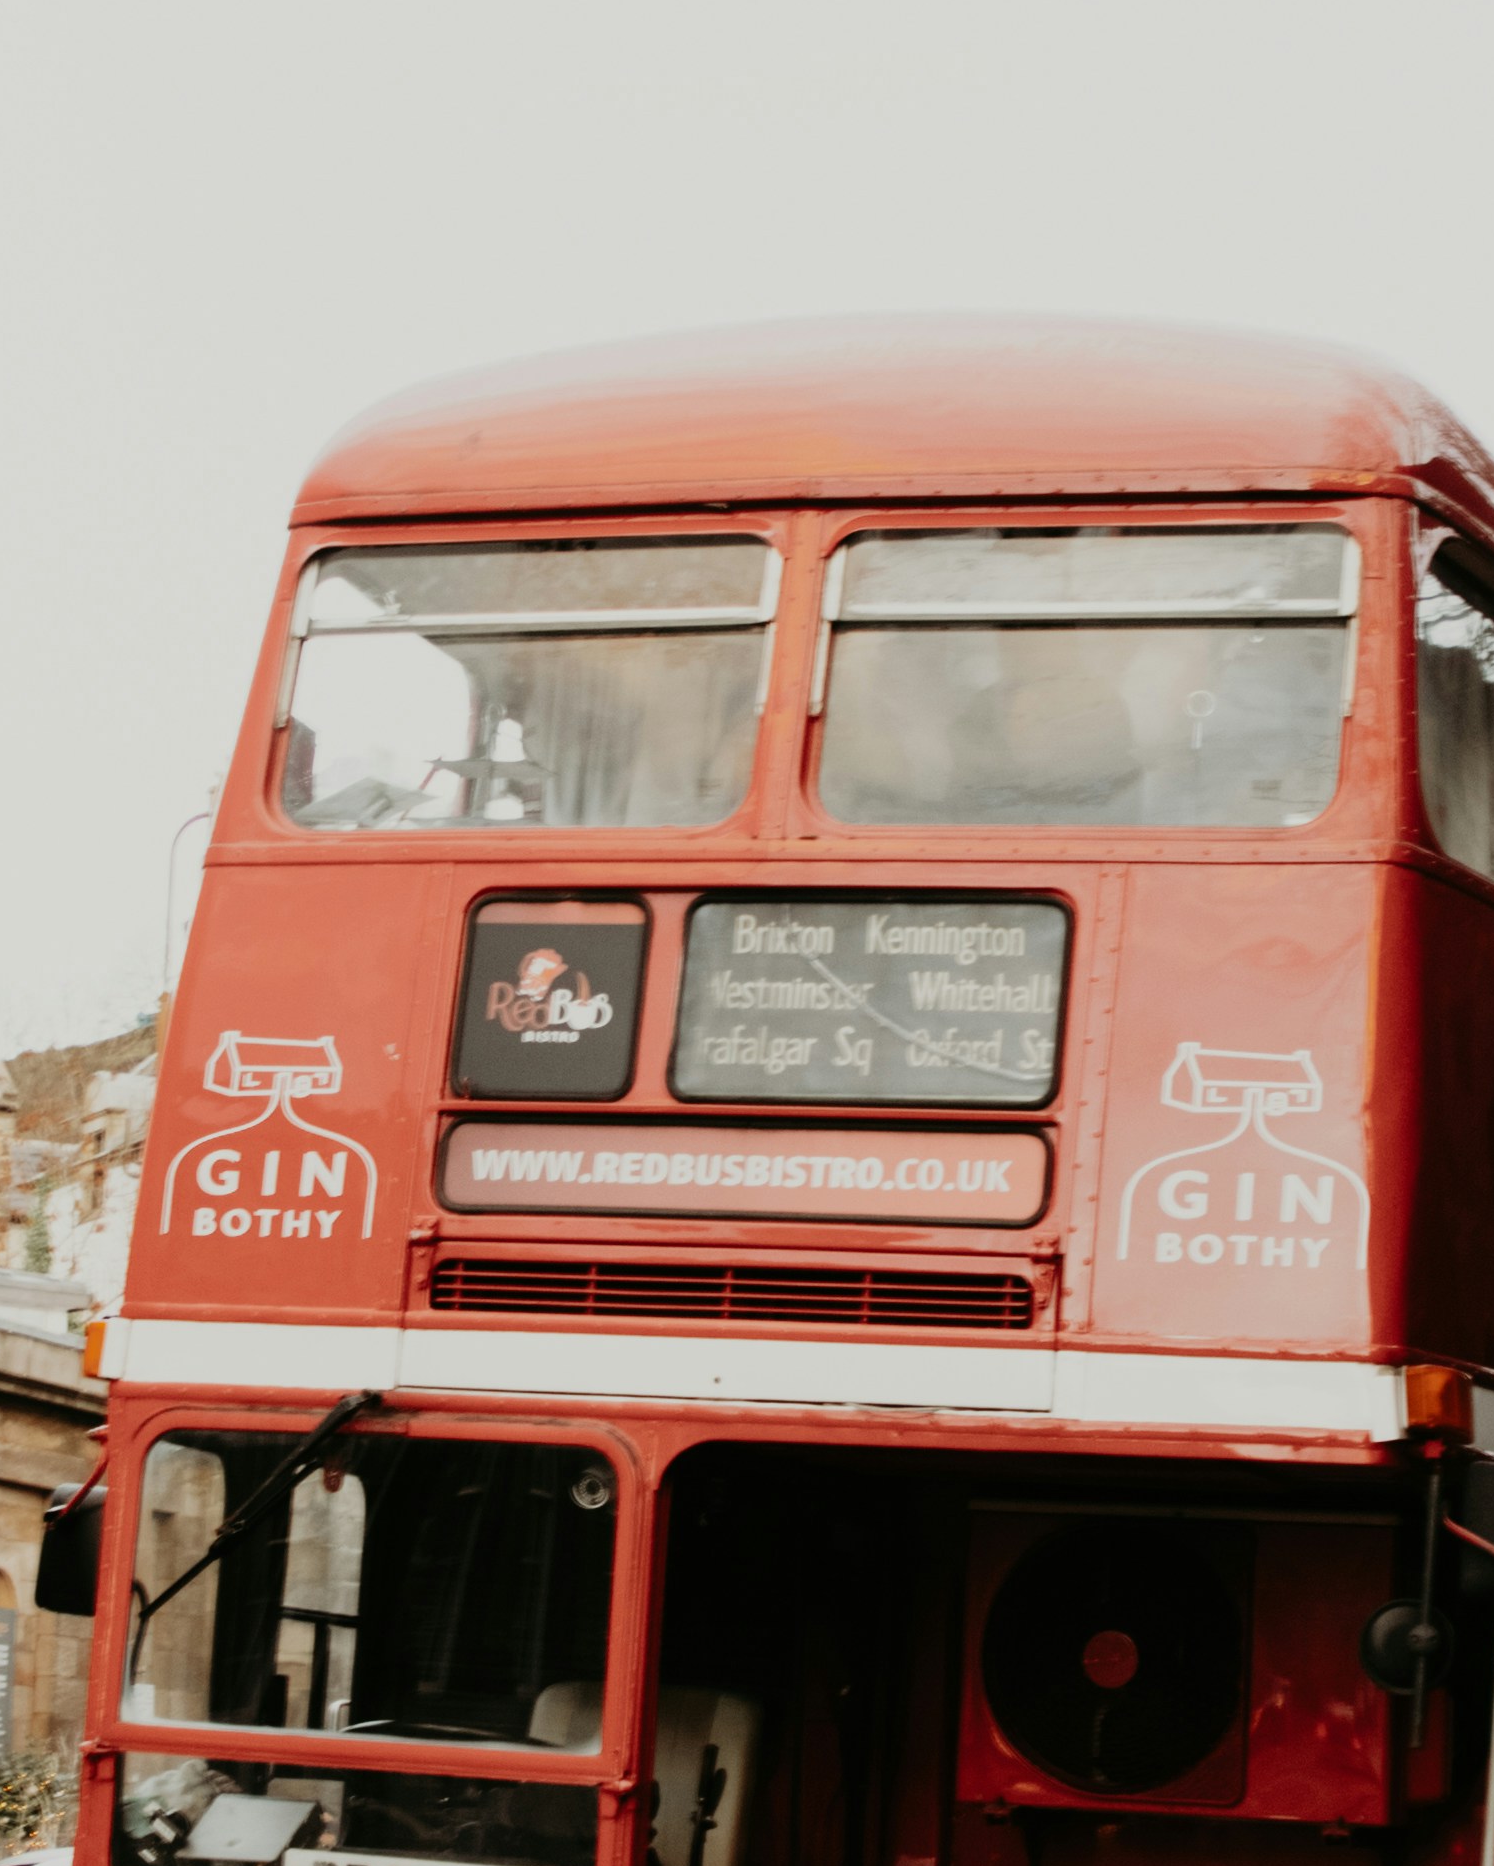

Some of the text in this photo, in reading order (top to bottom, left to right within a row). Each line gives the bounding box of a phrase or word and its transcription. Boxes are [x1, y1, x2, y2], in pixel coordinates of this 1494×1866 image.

[732, 913, 1025, 966] Brixton Kennington
[909, 970, 1056, 1014] Whitehall
[830, 1025, 875, 1077] Sq
[905, 1026, 1004, 1068] Oxford
[1016, 1028, 1055, 1070] St
[195, 1148, 349, 1199] GIN
[471, 1148, 1013, 1194] WWW.REDBUSBISTRO.CO.UK
[1158, 1169, 1335, 1225] GIN
[191, 1206, 343, 1239] BOTHY
[1155, 1231, 1331, 1269] BOTHY
